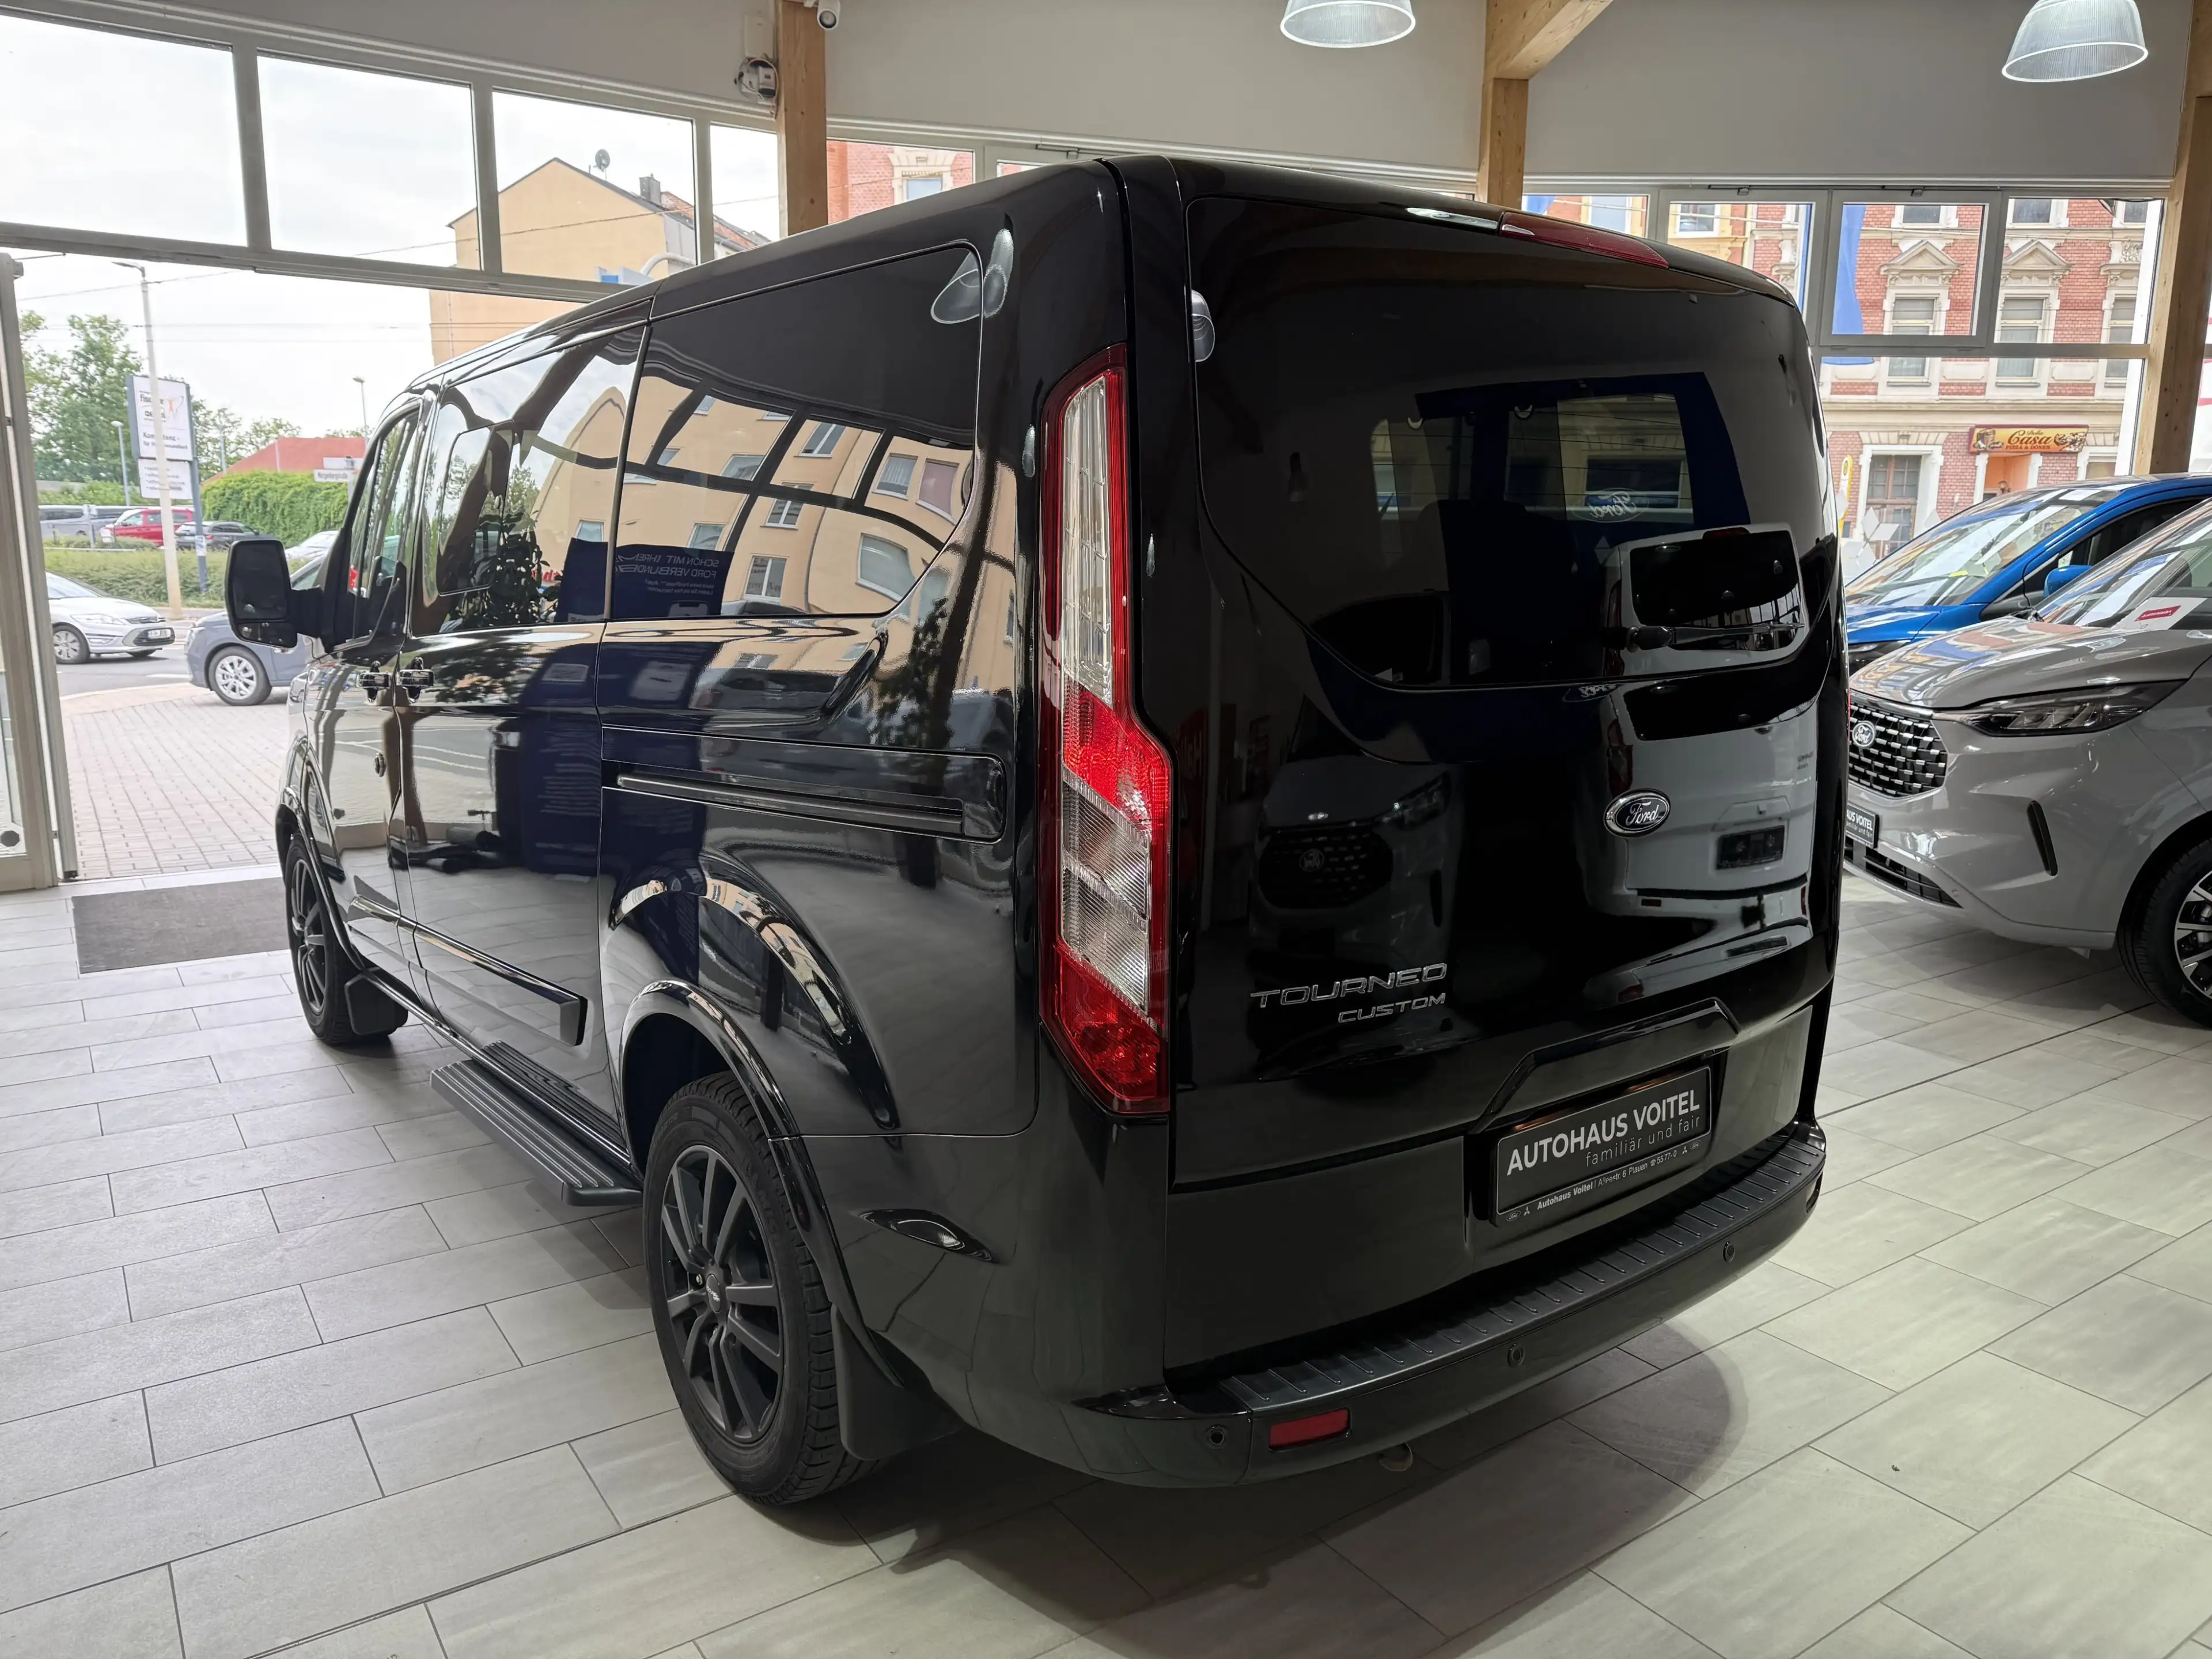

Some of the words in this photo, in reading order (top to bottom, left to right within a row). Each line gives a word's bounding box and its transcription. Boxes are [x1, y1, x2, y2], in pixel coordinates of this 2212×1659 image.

[2008, 430, 2052, 445] Casa
[1854, 725, 1872, 744] Ford
[1624, 801, 1660, 827] Ford
[1855, 813, 1873, 831] VOITEL
[1249, 963, 1448, 1009] TOURNEO
[1338, 993, 1446, 1024] CUSTOM
[1506, 1113, 1628, 1176] AUTOHAUS
[1633, 1089, 1700, 1130] VOITEL
[1585, 1137, 1642, 1167] familiär
[1648, 1123, 1672, 1145] und
[1678, 1116, 1700, 1134] fair
[1537, 1191, 1571, 1210] Autohaus
[1573, 1181, 1593, 1196] Voitel
[1622, 1170, 1627, 1178] 6
[1628, 1162, 1648, 1175] Plauen
